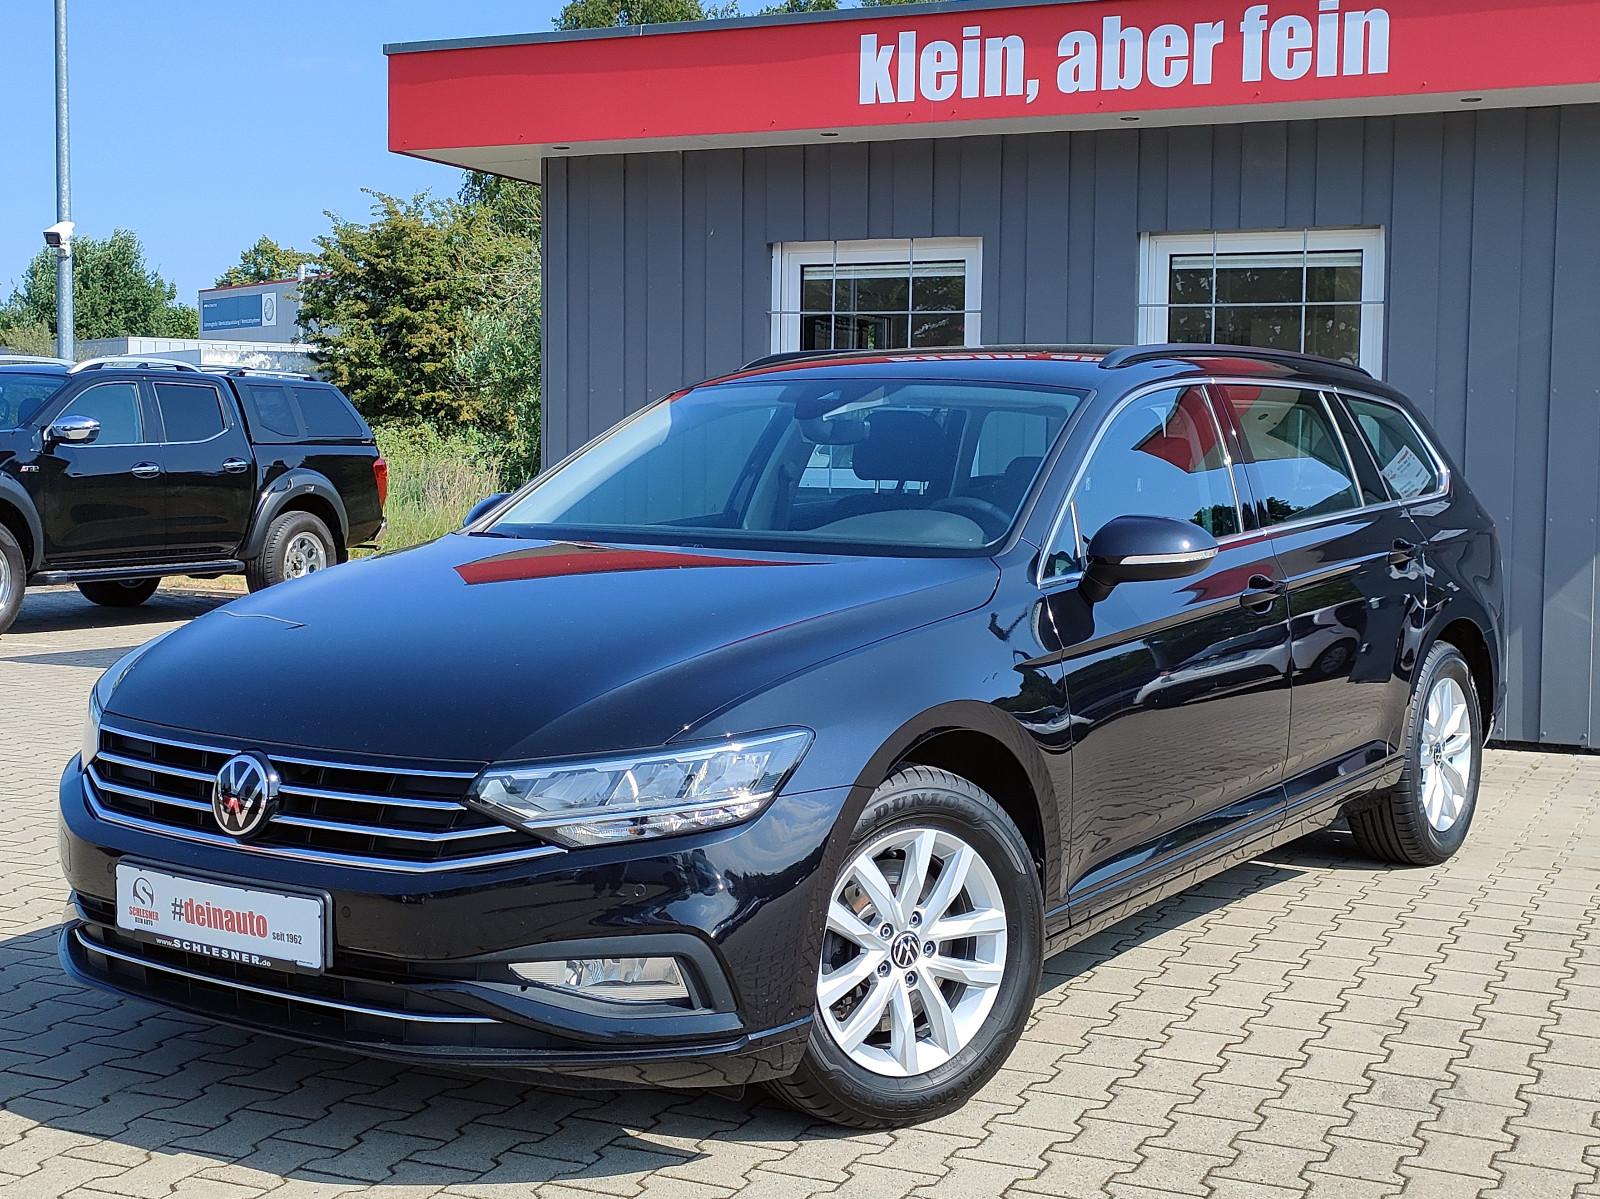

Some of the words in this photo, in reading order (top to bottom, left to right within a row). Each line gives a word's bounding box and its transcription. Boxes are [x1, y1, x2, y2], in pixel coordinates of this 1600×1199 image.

[858, 26, 1040, 105] klein,
[1056, 15, 1225, 95] aber
[1240, 0, 1390, 83] fein
[171, 897, 269, 939] #deinauto
[272, 931, 285, 943] seit
[286, 933, 303, 945] 1962
